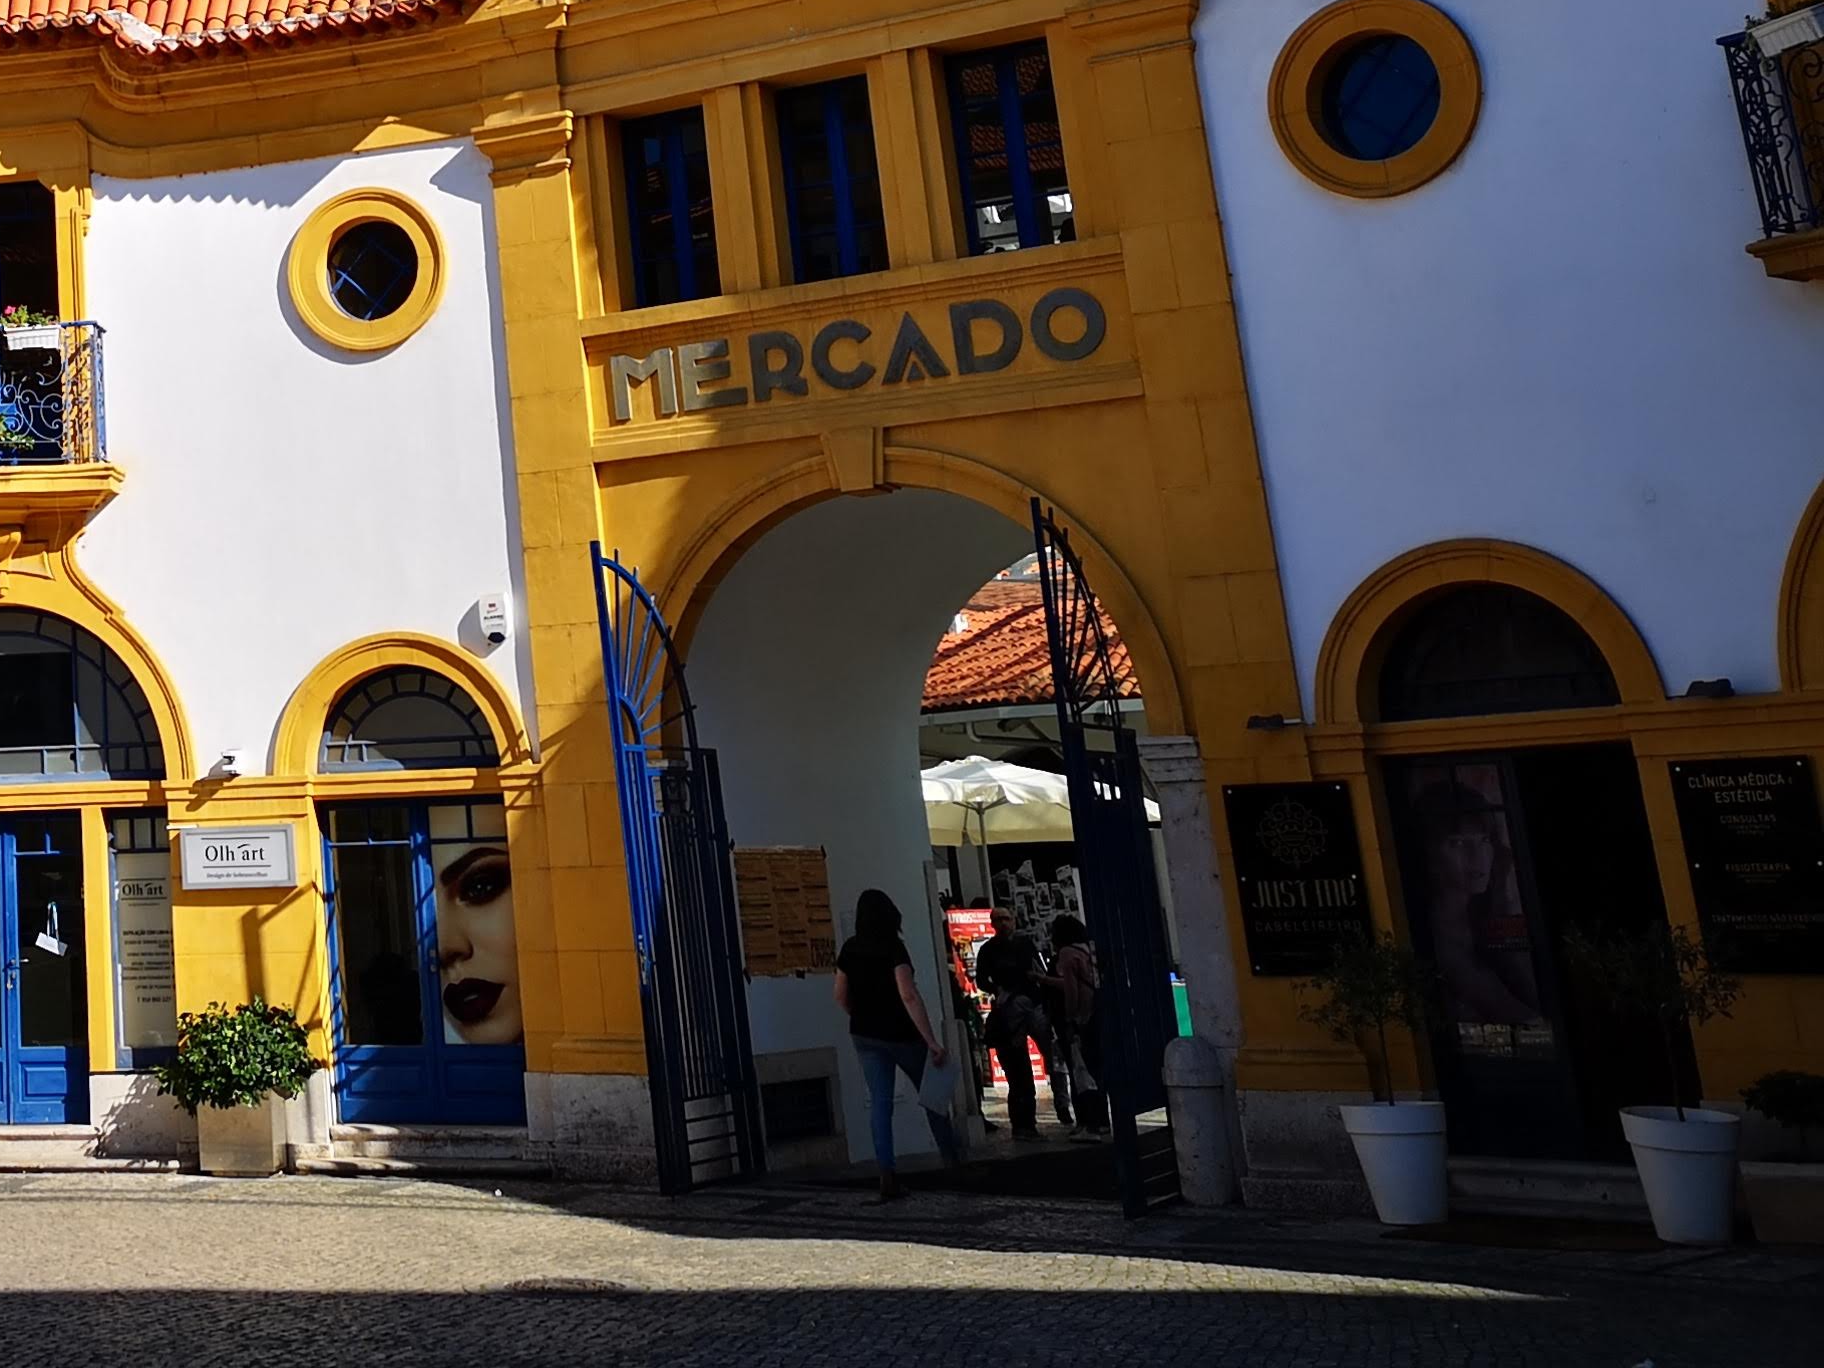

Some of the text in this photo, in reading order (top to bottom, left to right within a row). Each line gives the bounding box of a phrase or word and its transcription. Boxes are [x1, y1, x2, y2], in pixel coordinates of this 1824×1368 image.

[610, 287, 1107, 421] MERCADO
[1687, 774, 1734, 789] CLÍNICA
[1738, 772, 1786, 787] MÉDICA
[1714, 789, 1773, 804] ESTÉTICA
[1251, 879, 1308, 909] JUST
